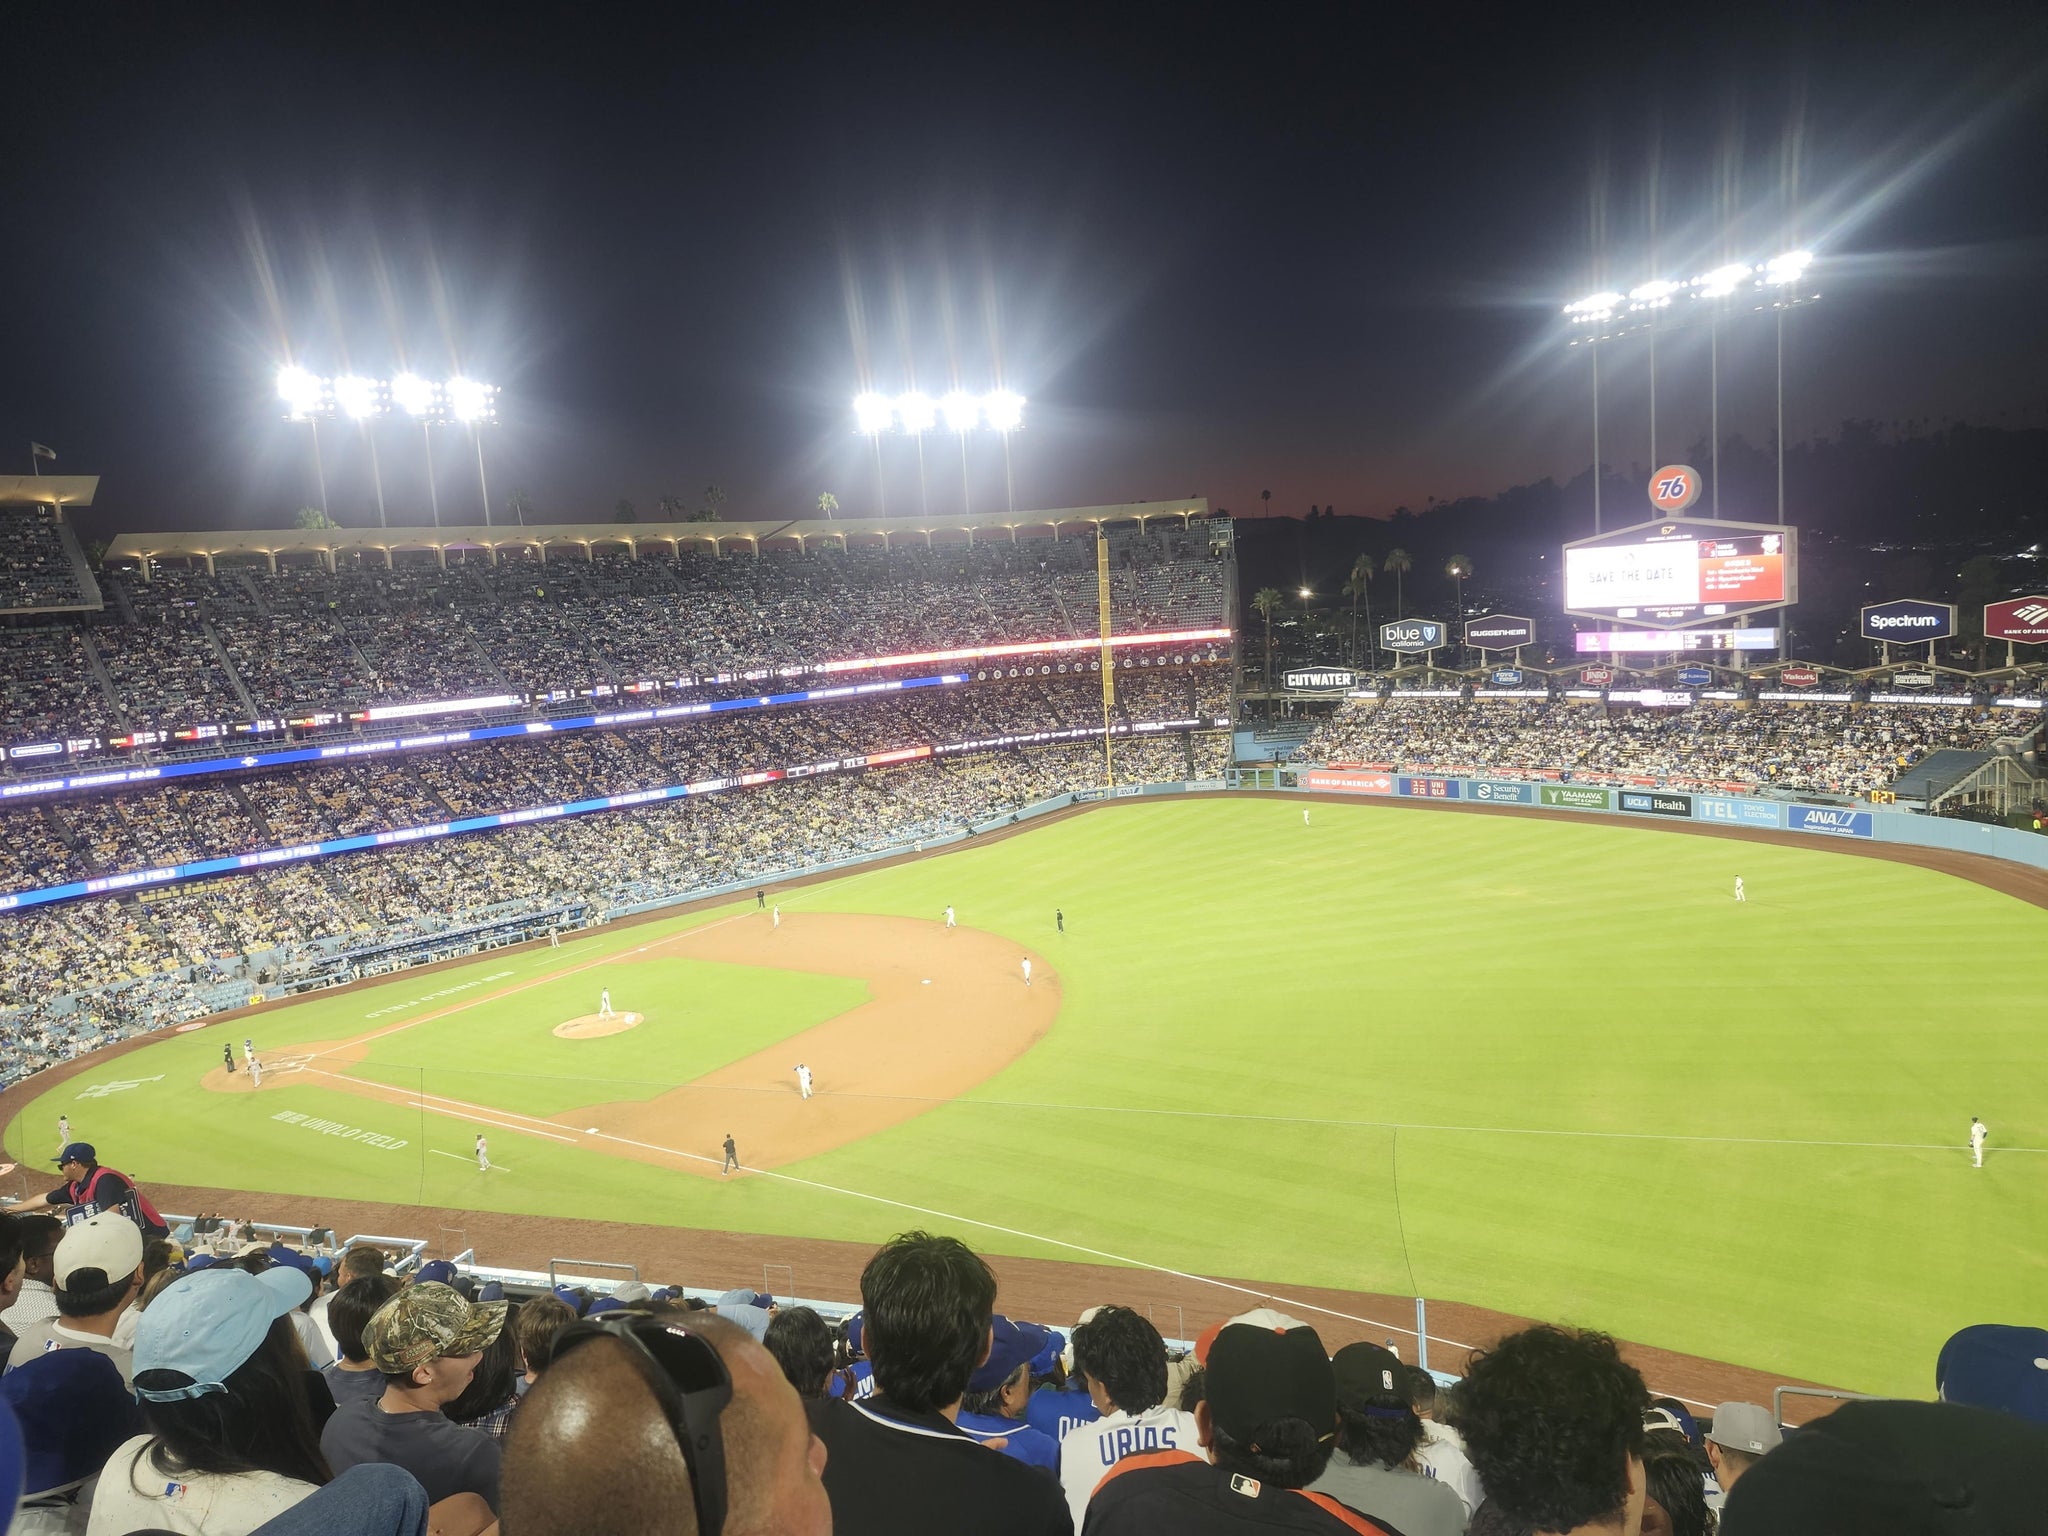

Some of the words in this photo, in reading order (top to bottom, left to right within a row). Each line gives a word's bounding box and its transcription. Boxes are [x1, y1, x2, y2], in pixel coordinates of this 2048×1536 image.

[1657, 475, 1686, 500] 76
[1589, 571, 1615, 584] SAVE
[1621, 569, 1640, 582] THE
[1646, 567, 1673, 581] DATE
[1870, 614, 1937, 630] Spectrum
[1386, 626, 1420, 641] blue
[1470, 629, 1527, 637] GUGGENHEIM
[1287, 673, 1352, 687] CUTWATER
[1586, 671, 1608, 681] JINRO
[1783, 673, 1816, 681] Yakult
[1758, 692, 1799, 700] ELECTRIFYING
[1799, 693, 1824, 701] DODGER
[1870, 695, 1914, 703] ELECTRIFYING
[1915, 696, 1941, 704] DODGER
[1941, 696, 1972, 704] STADIUM
[174, 730, 192, 738] FINAL
[321, 748, 346, 756] NEW
[347, 741, 397, 753] COASTER
[400, 736, 446, 746] SUMMER
[3, 781, 64, 796] COASTER
[69, 773, 127, 787] SUMMER
[1311, 777, 1329, 786] BANK
[1329, 778, 1340, 787] OF
[1340, 779, 1374, 788] AMERICA
[1117, 788, 1133, 797] ANA
[1431, 788, 1445, 796] QLO
[1492, 784, 1521, 794] Security
[1561, 790, 1602, 800] YAAMAVA
[1493, 791, 1518, 801] Benefit
[1627, 797, 1649, 807] UCLA
[1871, 790, 1895, 804] 0:27
[1654, 799, 1686, 811] Health
[1701, 800, 1737, 819] TEL
[1743, 804, 1765, 812] TOKYO
[1744, 811, 1777, 820] ELECTRON
[1804, 810, 1838, 825] ANA
[394, 828, 425, 840] UNIQLO
[424, 824, 449, 835] FIELD
[1803, 824, 1830, 833] Inspiration
[259, 849, 293, 862] UNIQLO
[294, 845, 321, 857] FIELD
[108, 873, 145, 888] UNIQLO
[146, 868, 176, 881] FIELD
[420, 981, 482, 1001] UNIQLO
[365, 1000, 419, 1019] FIELD
[300, 1117, 362, 1138] UNIQLO
[352, 1131, 409, 1150] FIELD
